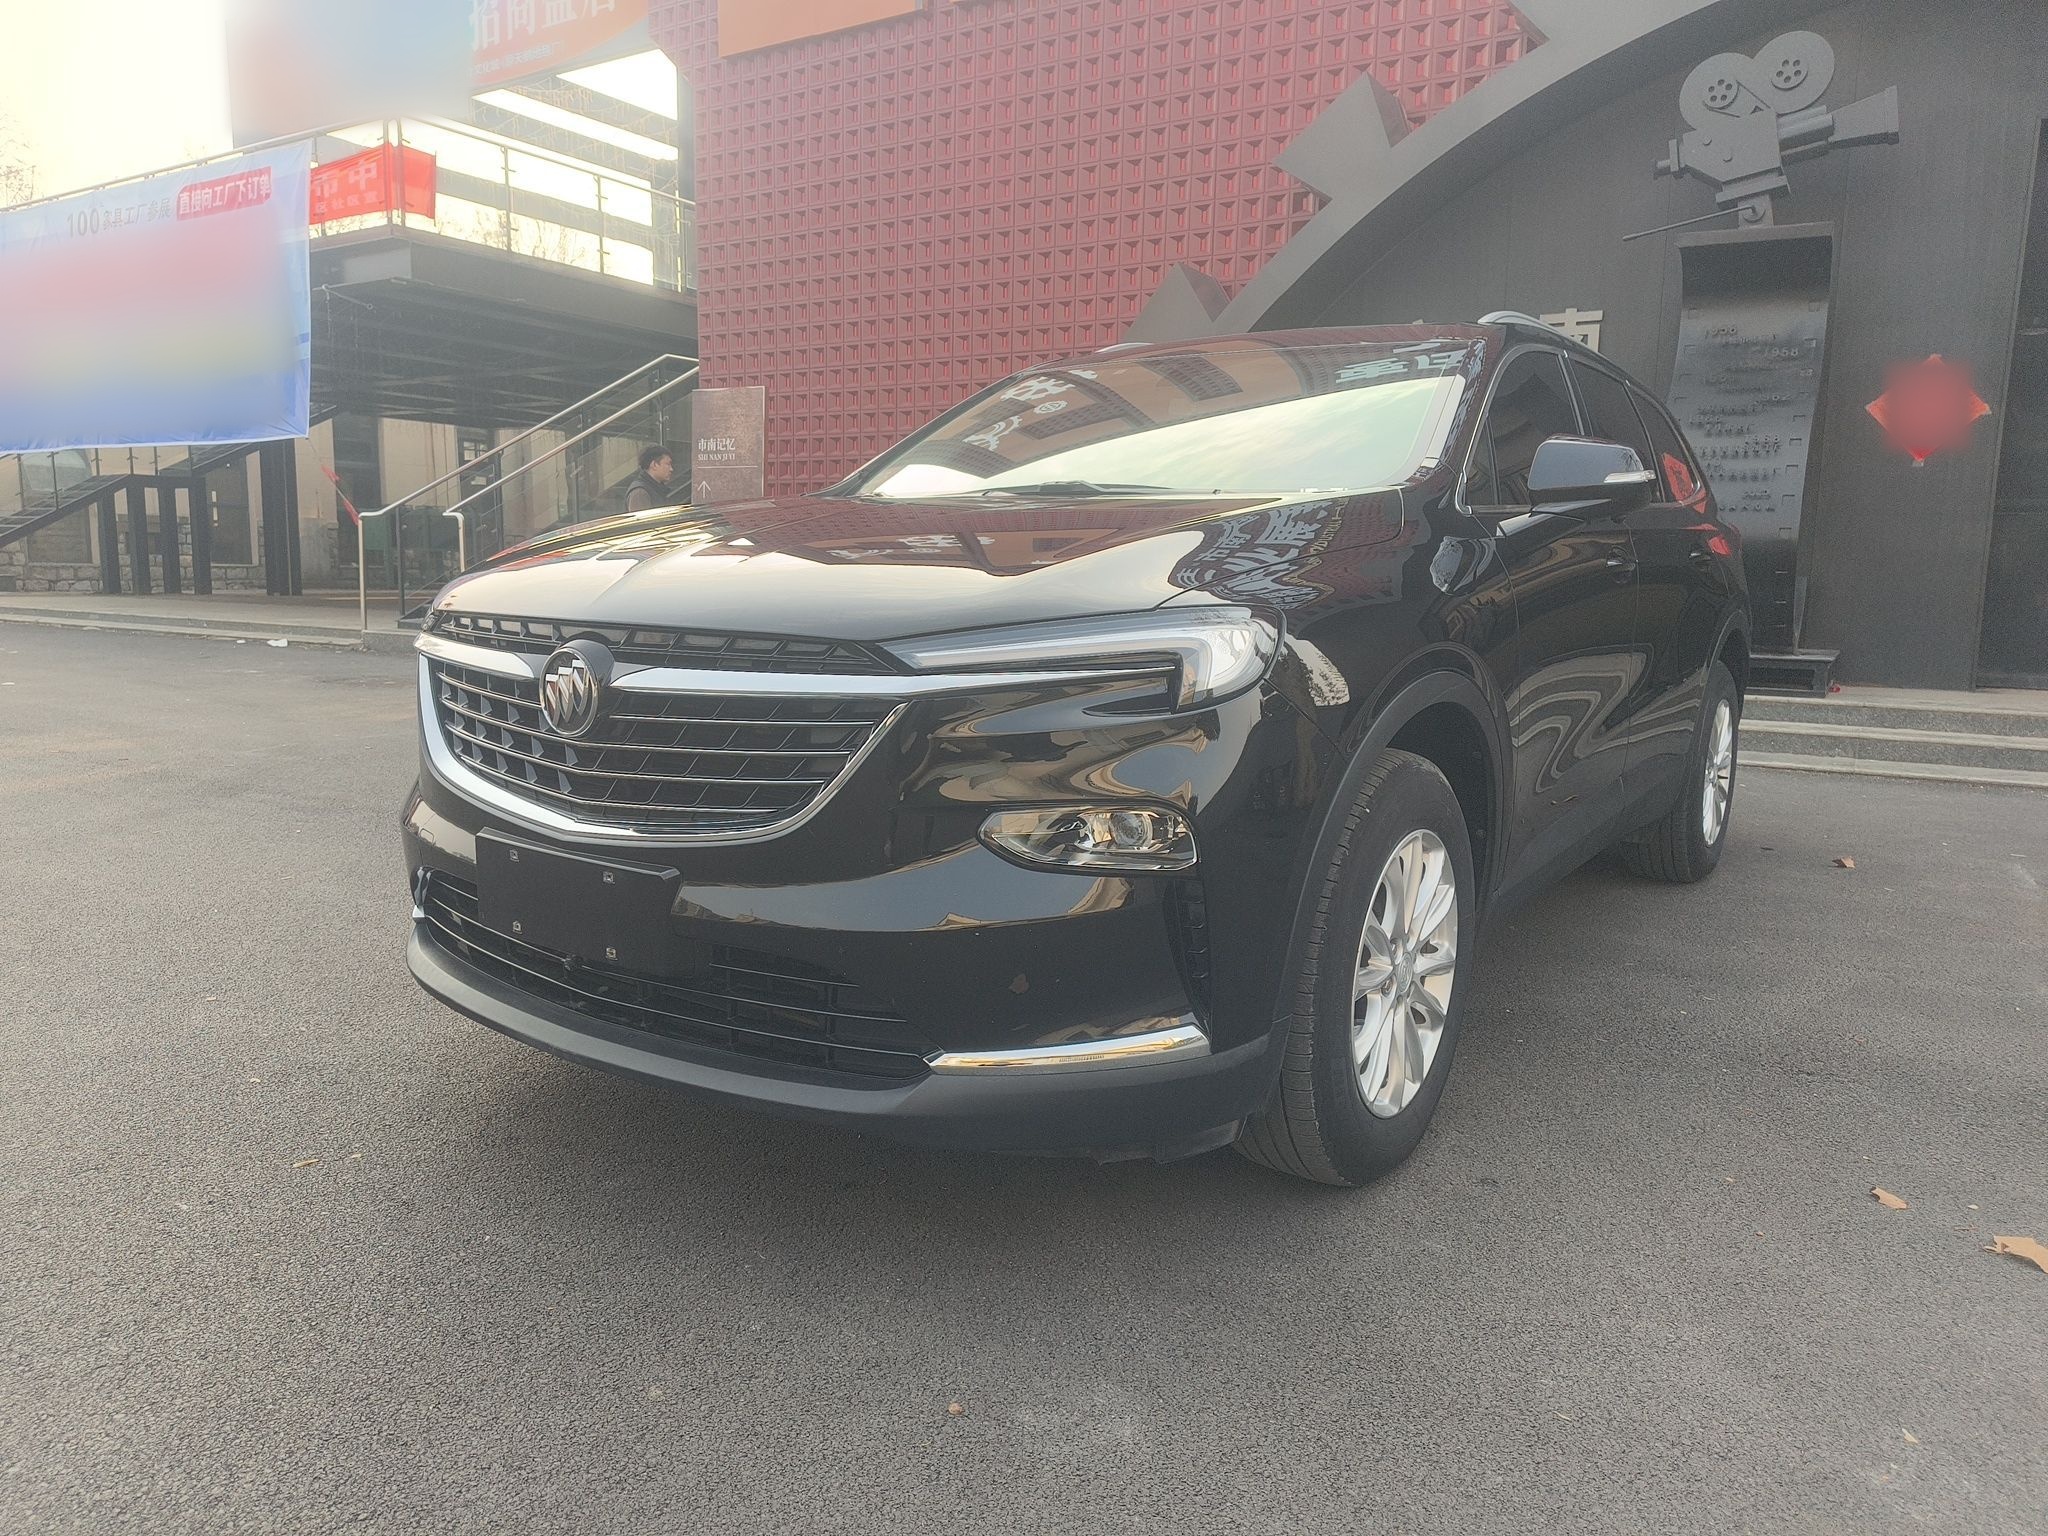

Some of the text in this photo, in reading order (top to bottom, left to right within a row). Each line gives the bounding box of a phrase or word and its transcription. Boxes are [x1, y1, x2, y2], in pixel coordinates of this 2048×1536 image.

[178, 173, 272, 215] 直接向工厂下订单
[698, 437, 736, 452] 市南记忆
[709, 453, 722, 461] NAN
